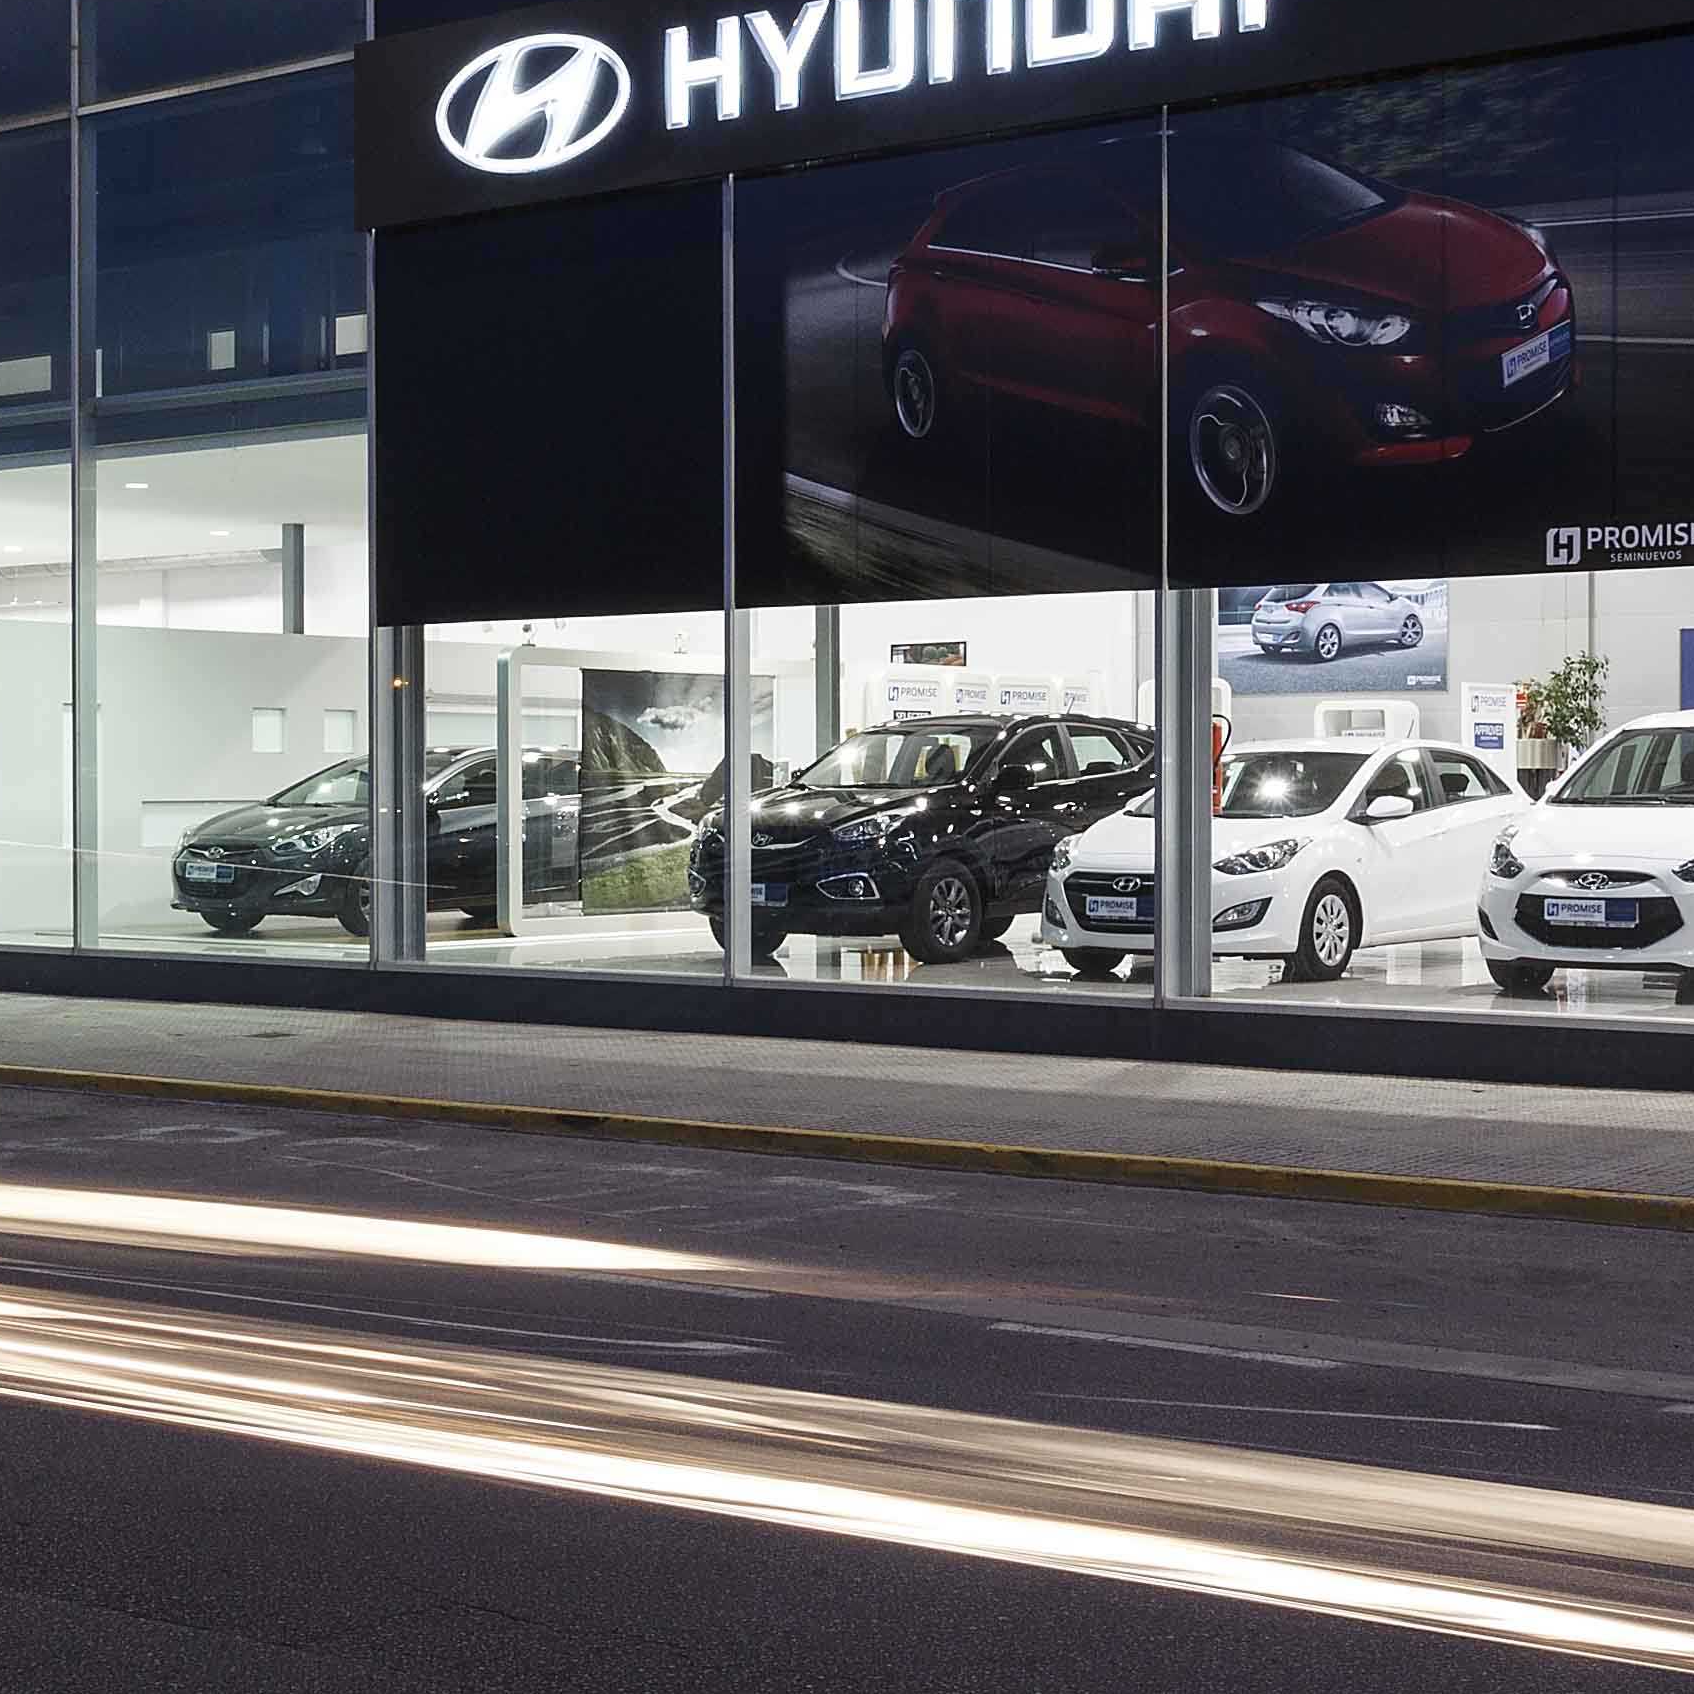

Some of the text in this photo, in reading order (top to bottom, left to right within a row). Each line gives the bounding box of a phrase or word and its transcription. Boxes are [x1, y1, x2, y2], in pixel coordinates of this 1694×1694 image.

[1517, 340, 1547, 365] PROMISE
[1610, 550, 1682, 562] SEMINUEVOS
[901, 687, 938, 697] PROMISE
[1012, 691, 1047, 700] PROMISE
[1100, 900, 1135, 910] PROMISE
[1561, 904, 1603, 914] PROMISE
